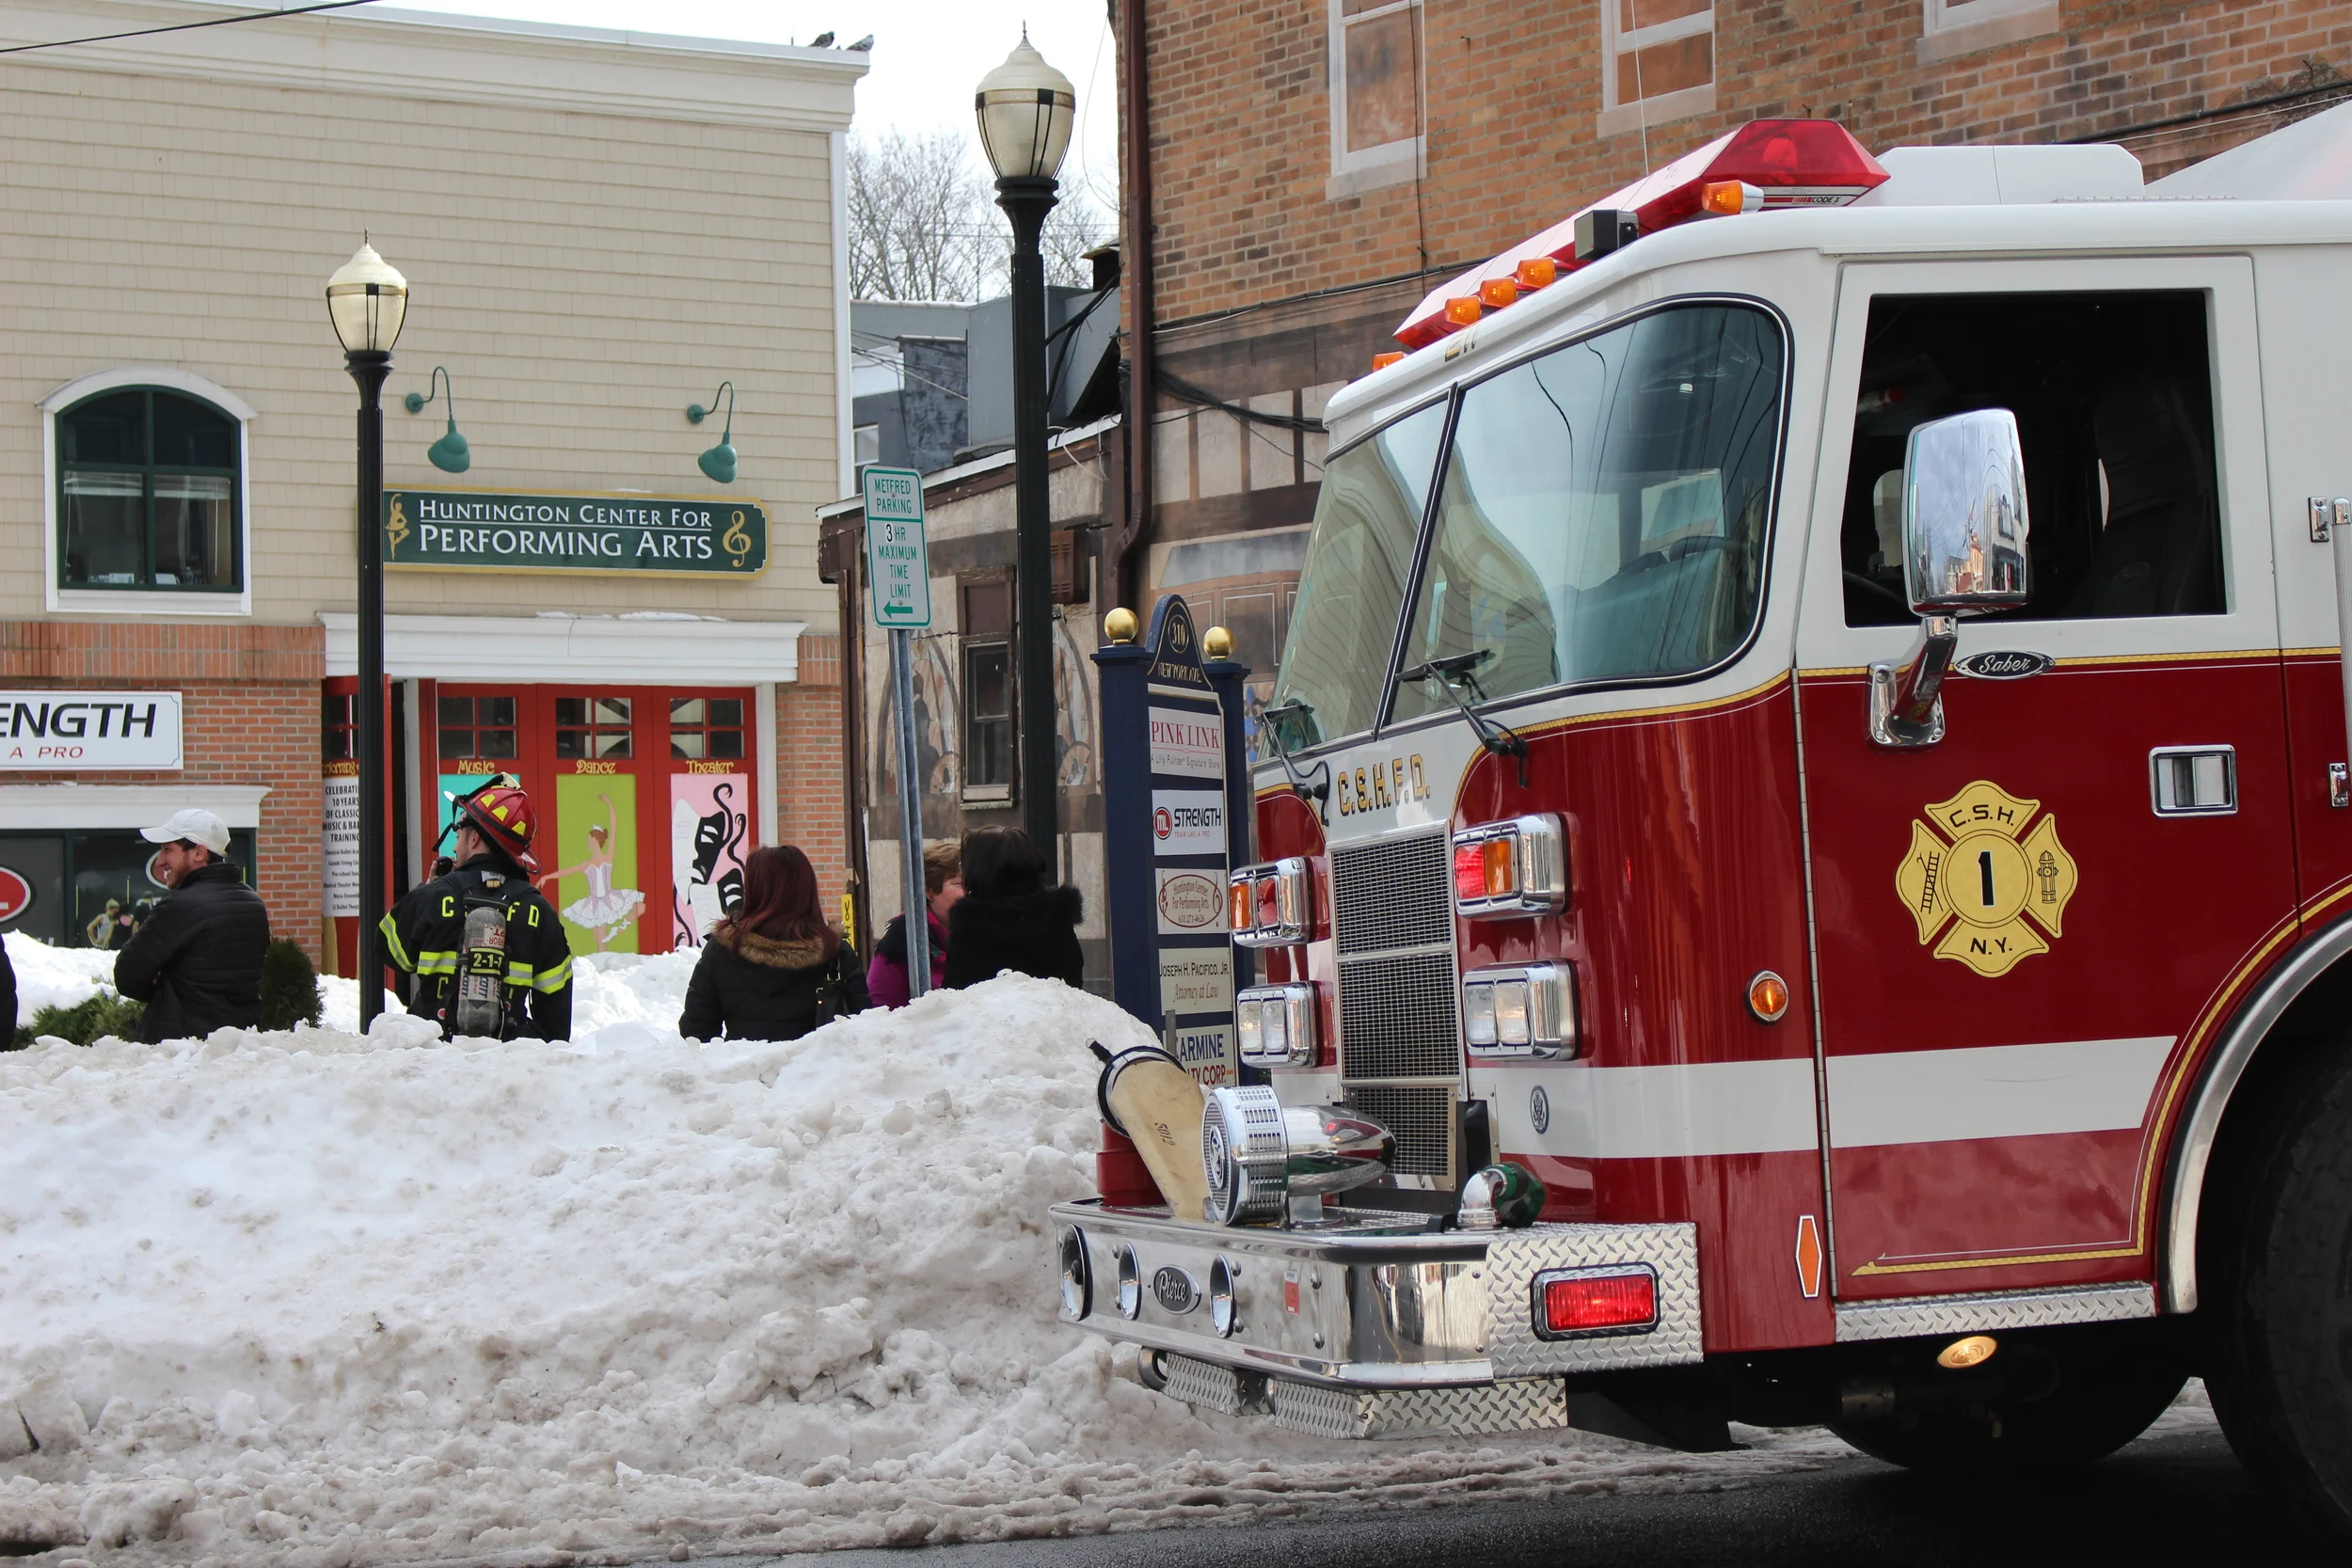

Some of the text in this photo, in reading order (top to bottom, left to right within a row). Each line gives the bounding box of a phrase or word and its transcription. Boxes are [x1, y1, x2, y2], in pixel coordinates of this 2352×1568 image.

[420, 499, 712, 528] HUNTINGTON CENTER FOR
[876, 498, 913, 514] PARKING
[420, 524, 713, 559] PERFORMING ARTS
[886, 523, 906, 543] 3 HR
[878, 546, 917, 562] MAXIMUM
[889, 564, 909, 579] TIME
[890, 584, 911, 598] LIMIT
[1172, 622, 1185, 646] 310
[1158, 661, 1171, 678] NEW
[1172, 663, 1189, 681] YORK
[1979, 654, 2031, 673] Saber
[1151, 721, 1219, 749] PINK LINK
[9, 746, 84, 759] A PRO
[576, 759, 616, 774] Dance
[686, 760, 735, 774] Theater
[332, 798, 340, 806] 10
[326, 810, 334, 819] OF
[1174, 807, 1221, 828] STRENGTH
[1949, 804, 2014, 828] C.S.H.
[322, 821, 341, 831] MUSIC
[1978, 850, 1994, 908] 1
[1970, 937, 2012, 955] N.Y.
[1159, 962, 1183, 977] JOSEPH
[1176, 1033, 1225, 1062] ARMINE
[1158, 1270, 1187, 1303] Pierce
